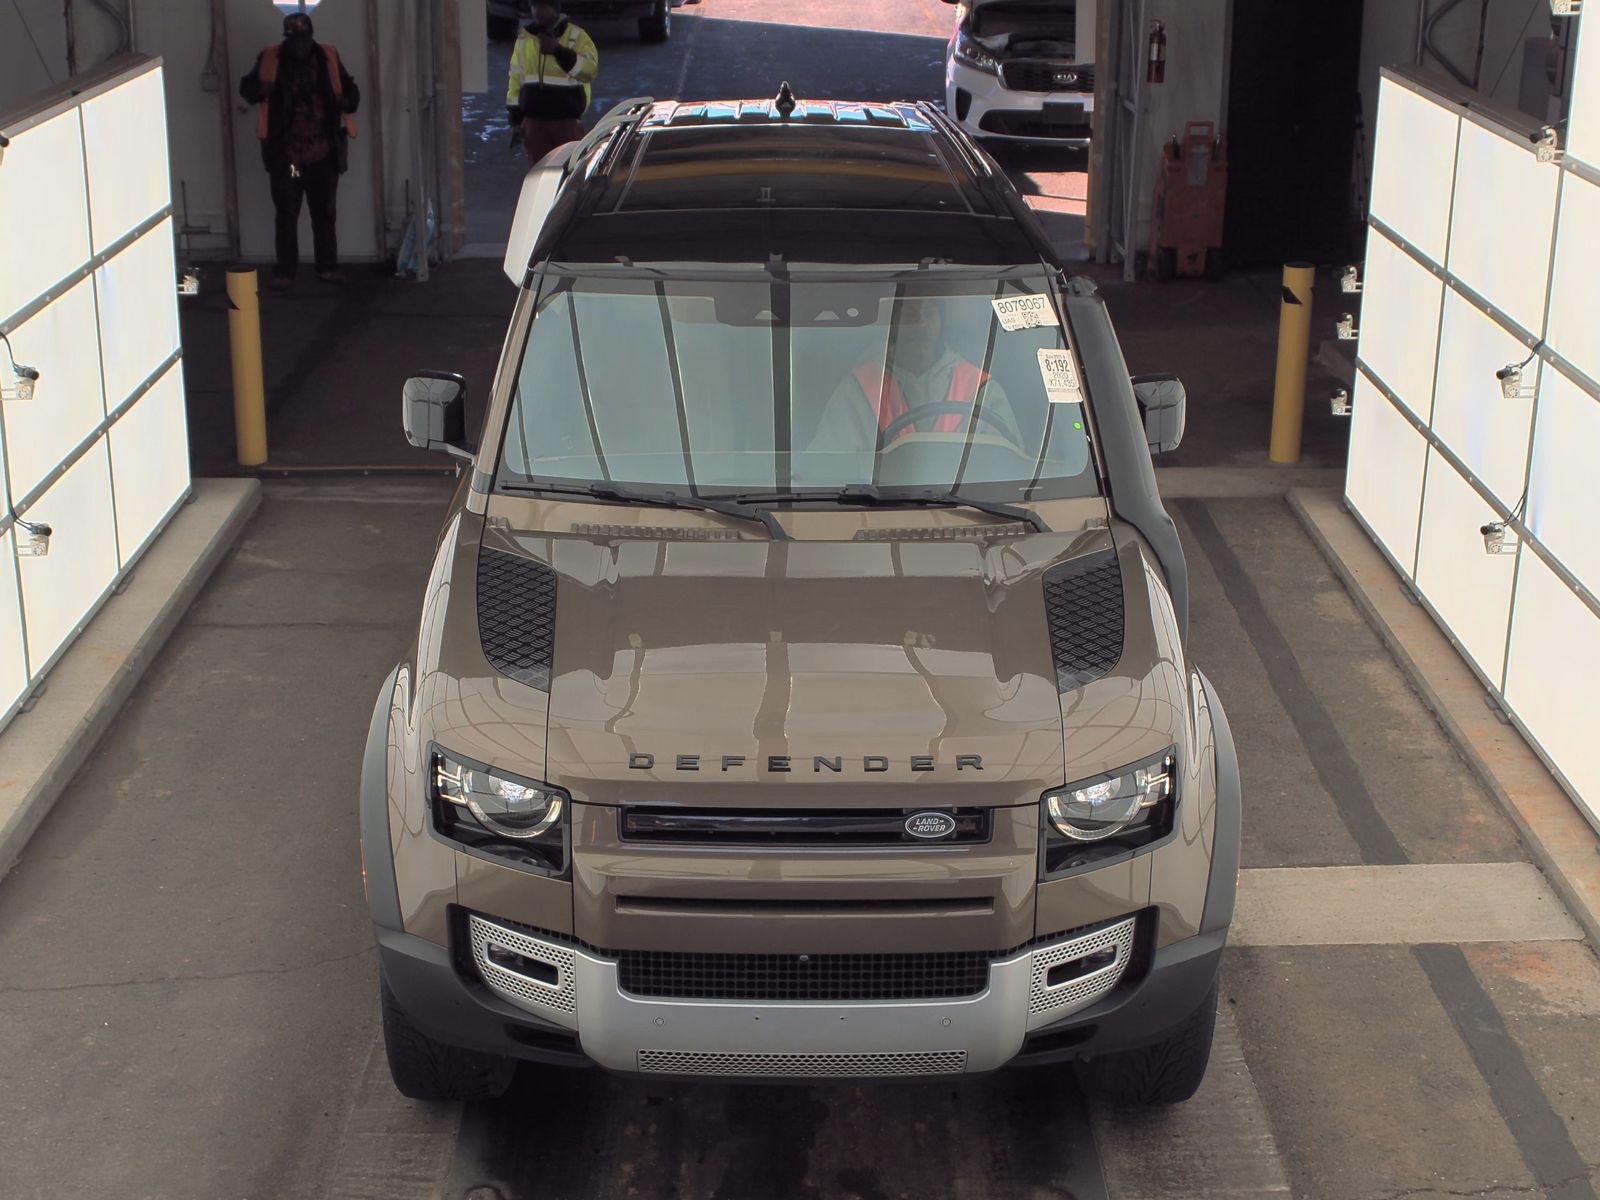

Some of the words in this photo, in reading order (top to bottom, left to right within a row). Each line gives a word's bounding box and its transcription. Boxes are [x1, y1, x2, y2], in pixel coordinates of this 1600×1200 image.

[997, 297, 1045, 314] 8079067
[1045, 359, 1070, 372] 8:192
[628, 753, 984, 772] DEFENDER
